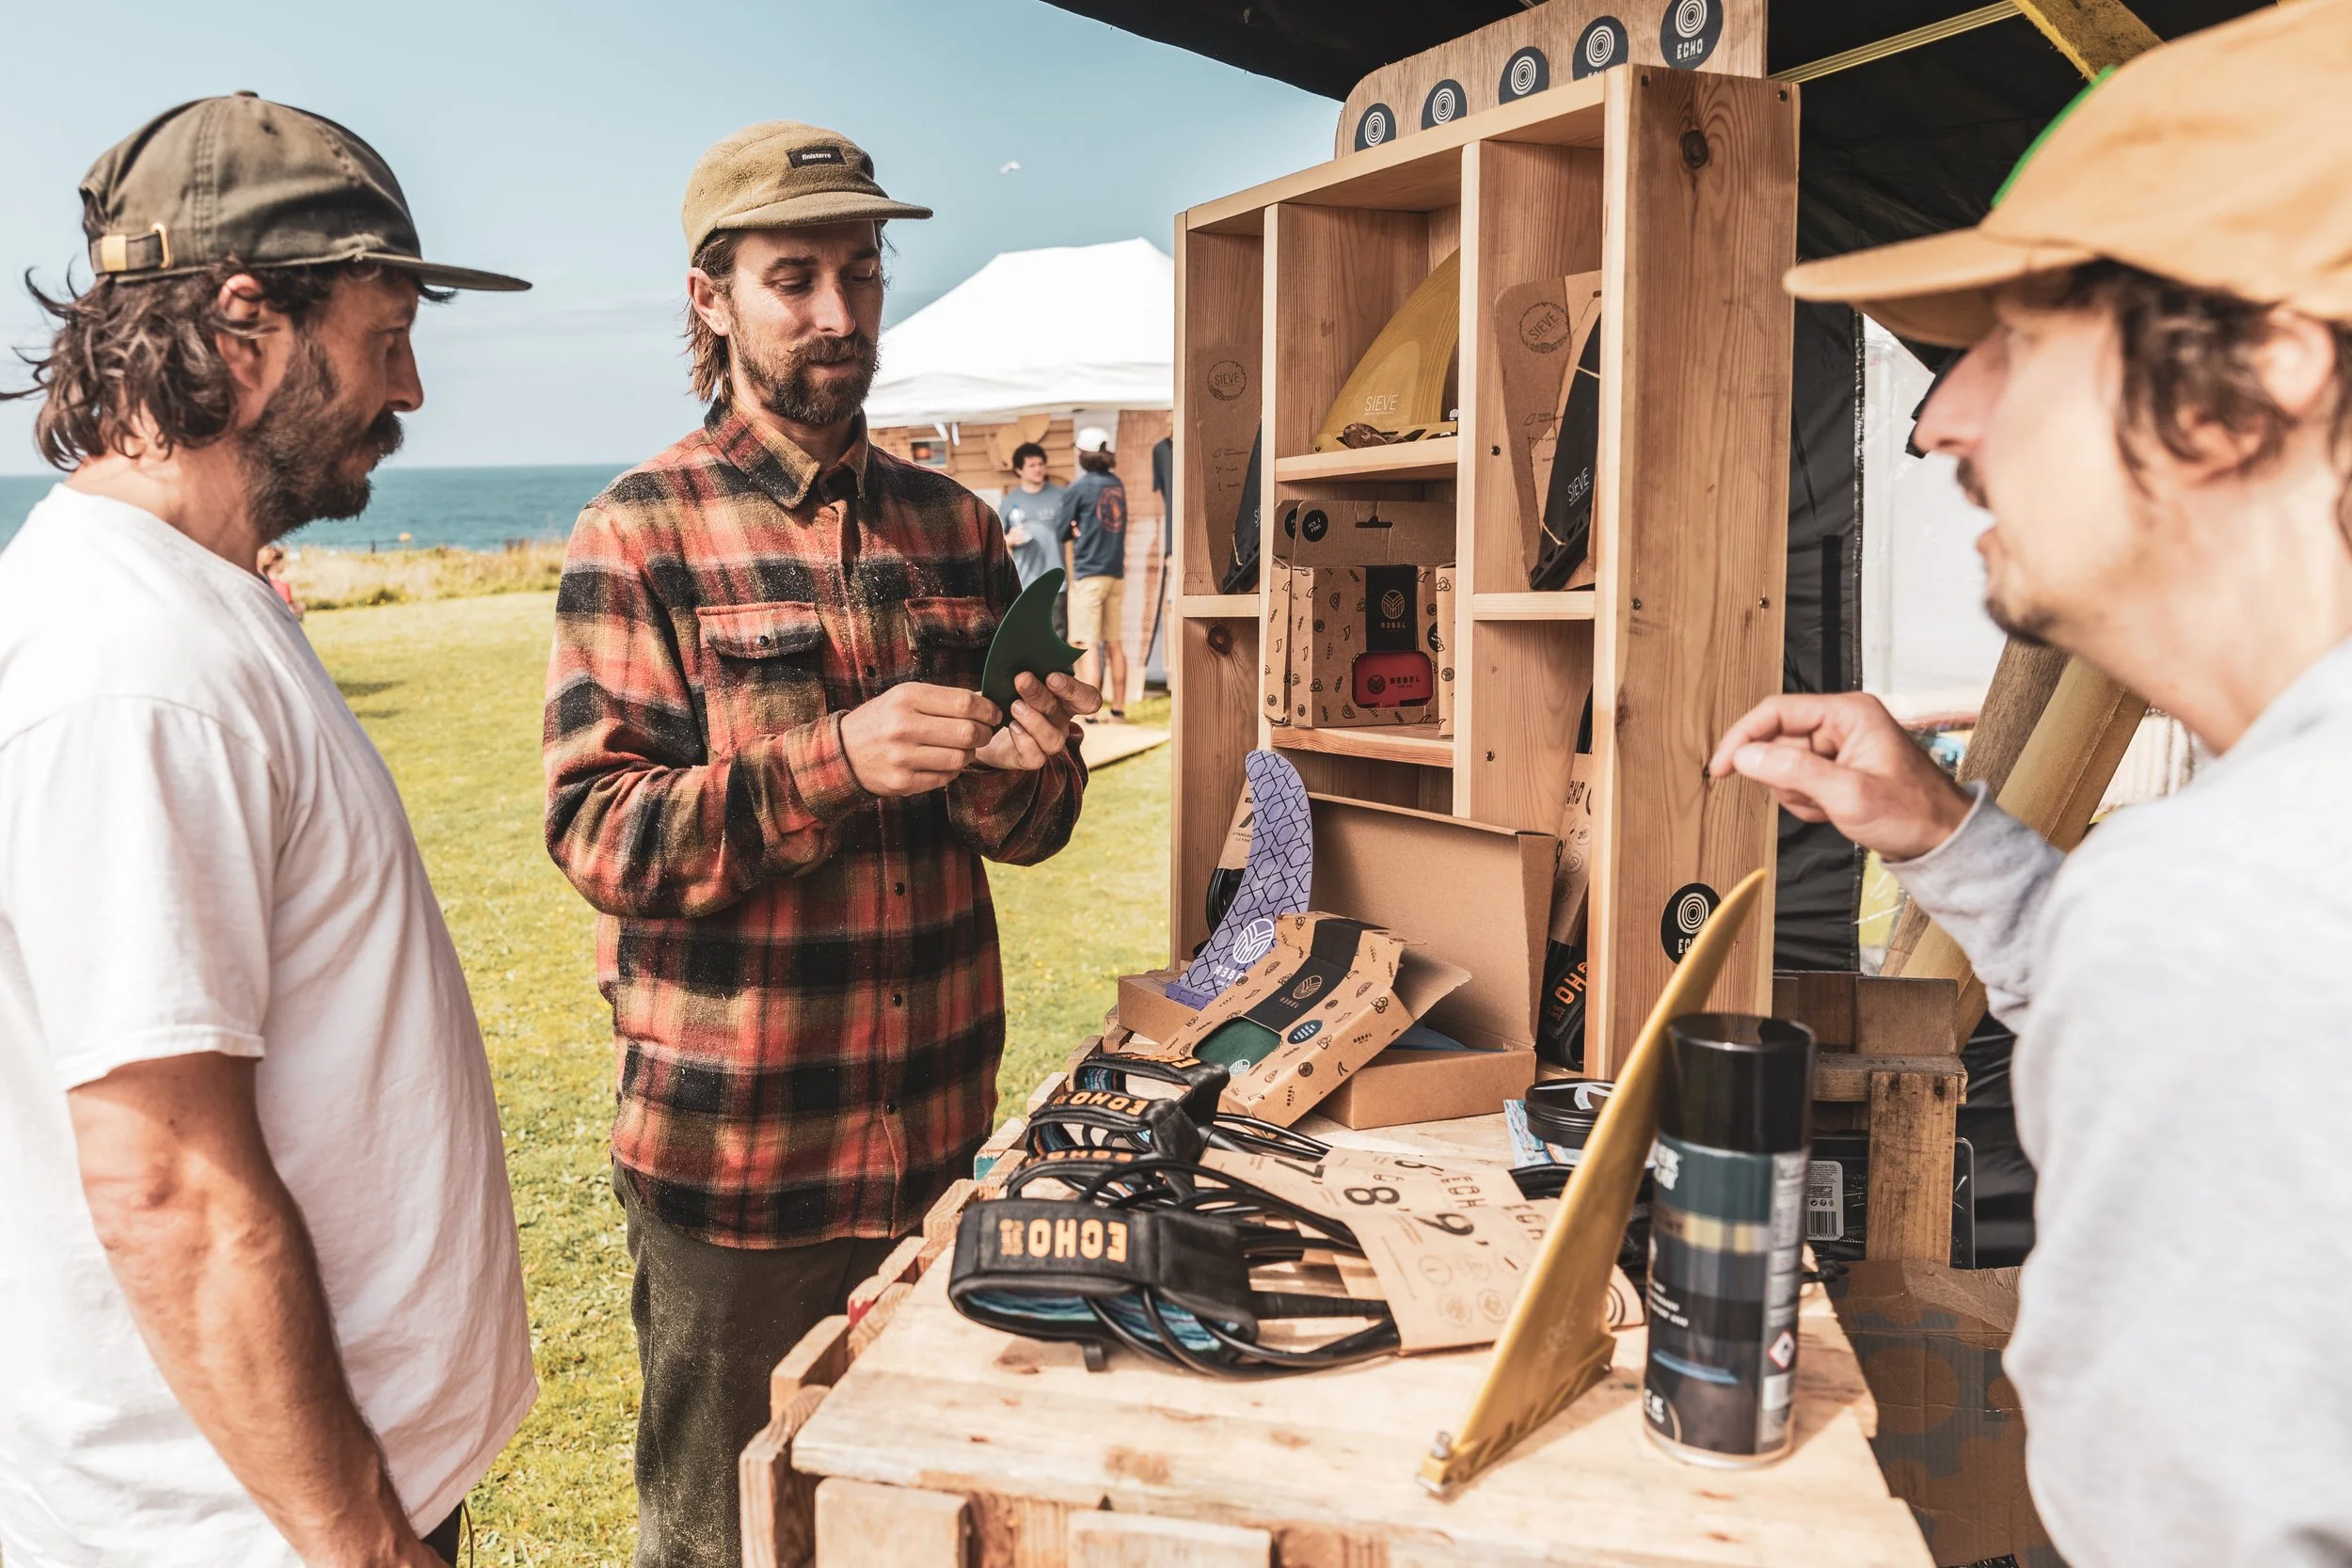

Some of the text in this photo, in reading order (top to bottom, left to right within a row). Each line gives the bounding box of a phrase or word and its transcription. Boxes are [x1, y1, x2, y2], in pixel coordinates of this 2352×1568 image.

[1677, 39, 1704, 59] ECHO
[802, 152, 832, 161] finisterre
[1528, 310, 1559, 341] SIEVE
[1214, 372, 1240, 386] SIEVE
[1364, 394, 1399, 412] SIEVE
[1567, 467, 1590, 502] SIEVE
[1069, 1091, 1151, 1117] ECHO
[1027, 1218, 1128, 1263] ECHO
